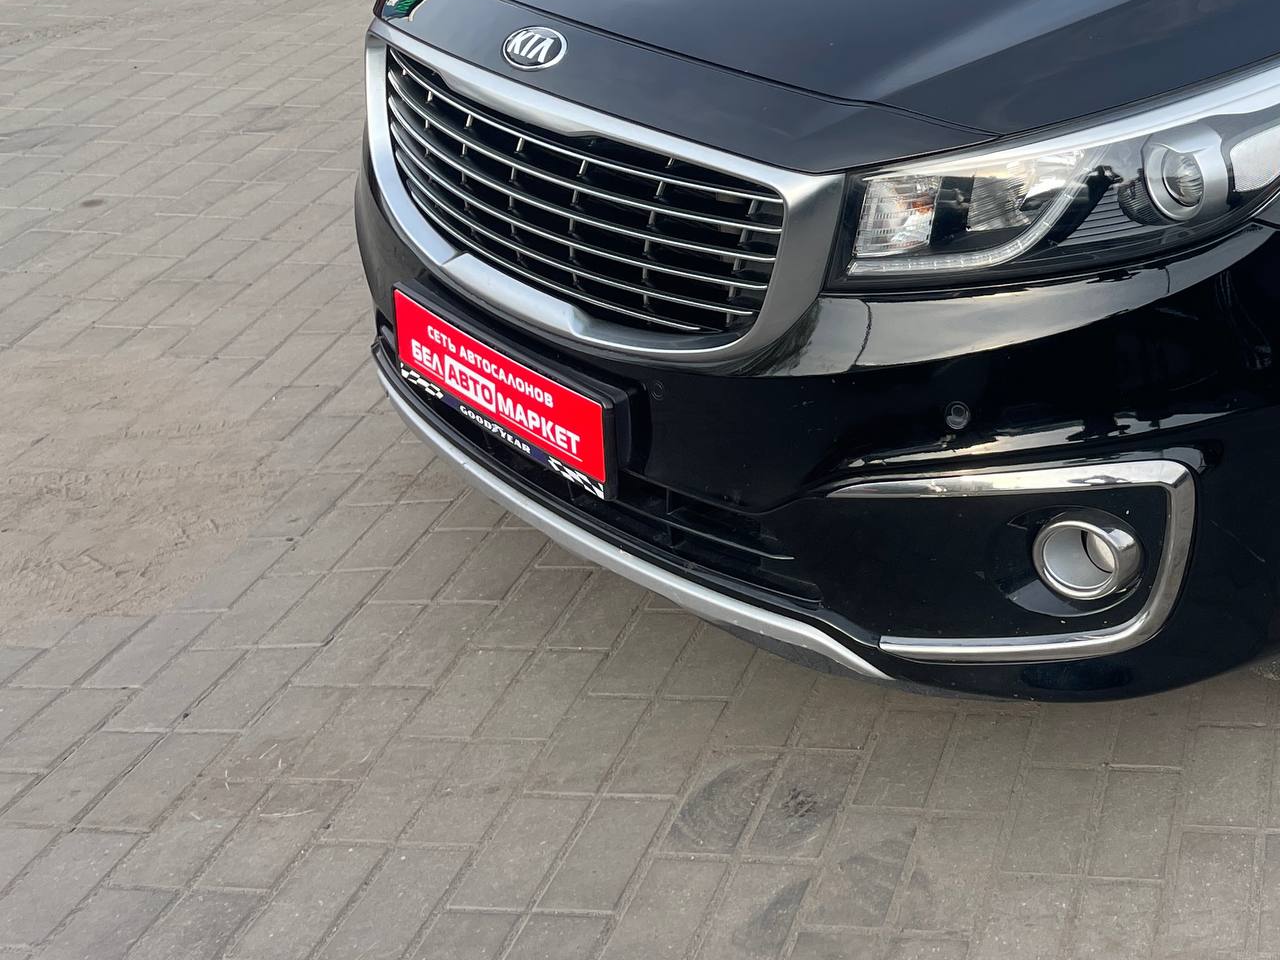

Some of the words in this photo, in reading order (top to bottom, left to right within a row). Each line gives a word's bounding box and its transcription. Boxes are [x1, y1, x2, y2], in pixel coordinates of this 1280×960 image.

[506, 30, 555, 64] KIA
[411, 338, 443, 377] БЕЛ
[448, 365, 494, 404] АВТО
[496, 391, 581, 455] МАРКЕТ
[427, 324, 457, 354] СЕТЬ
[459, 345, 554, 408] АВТОСАЛОНОВ
